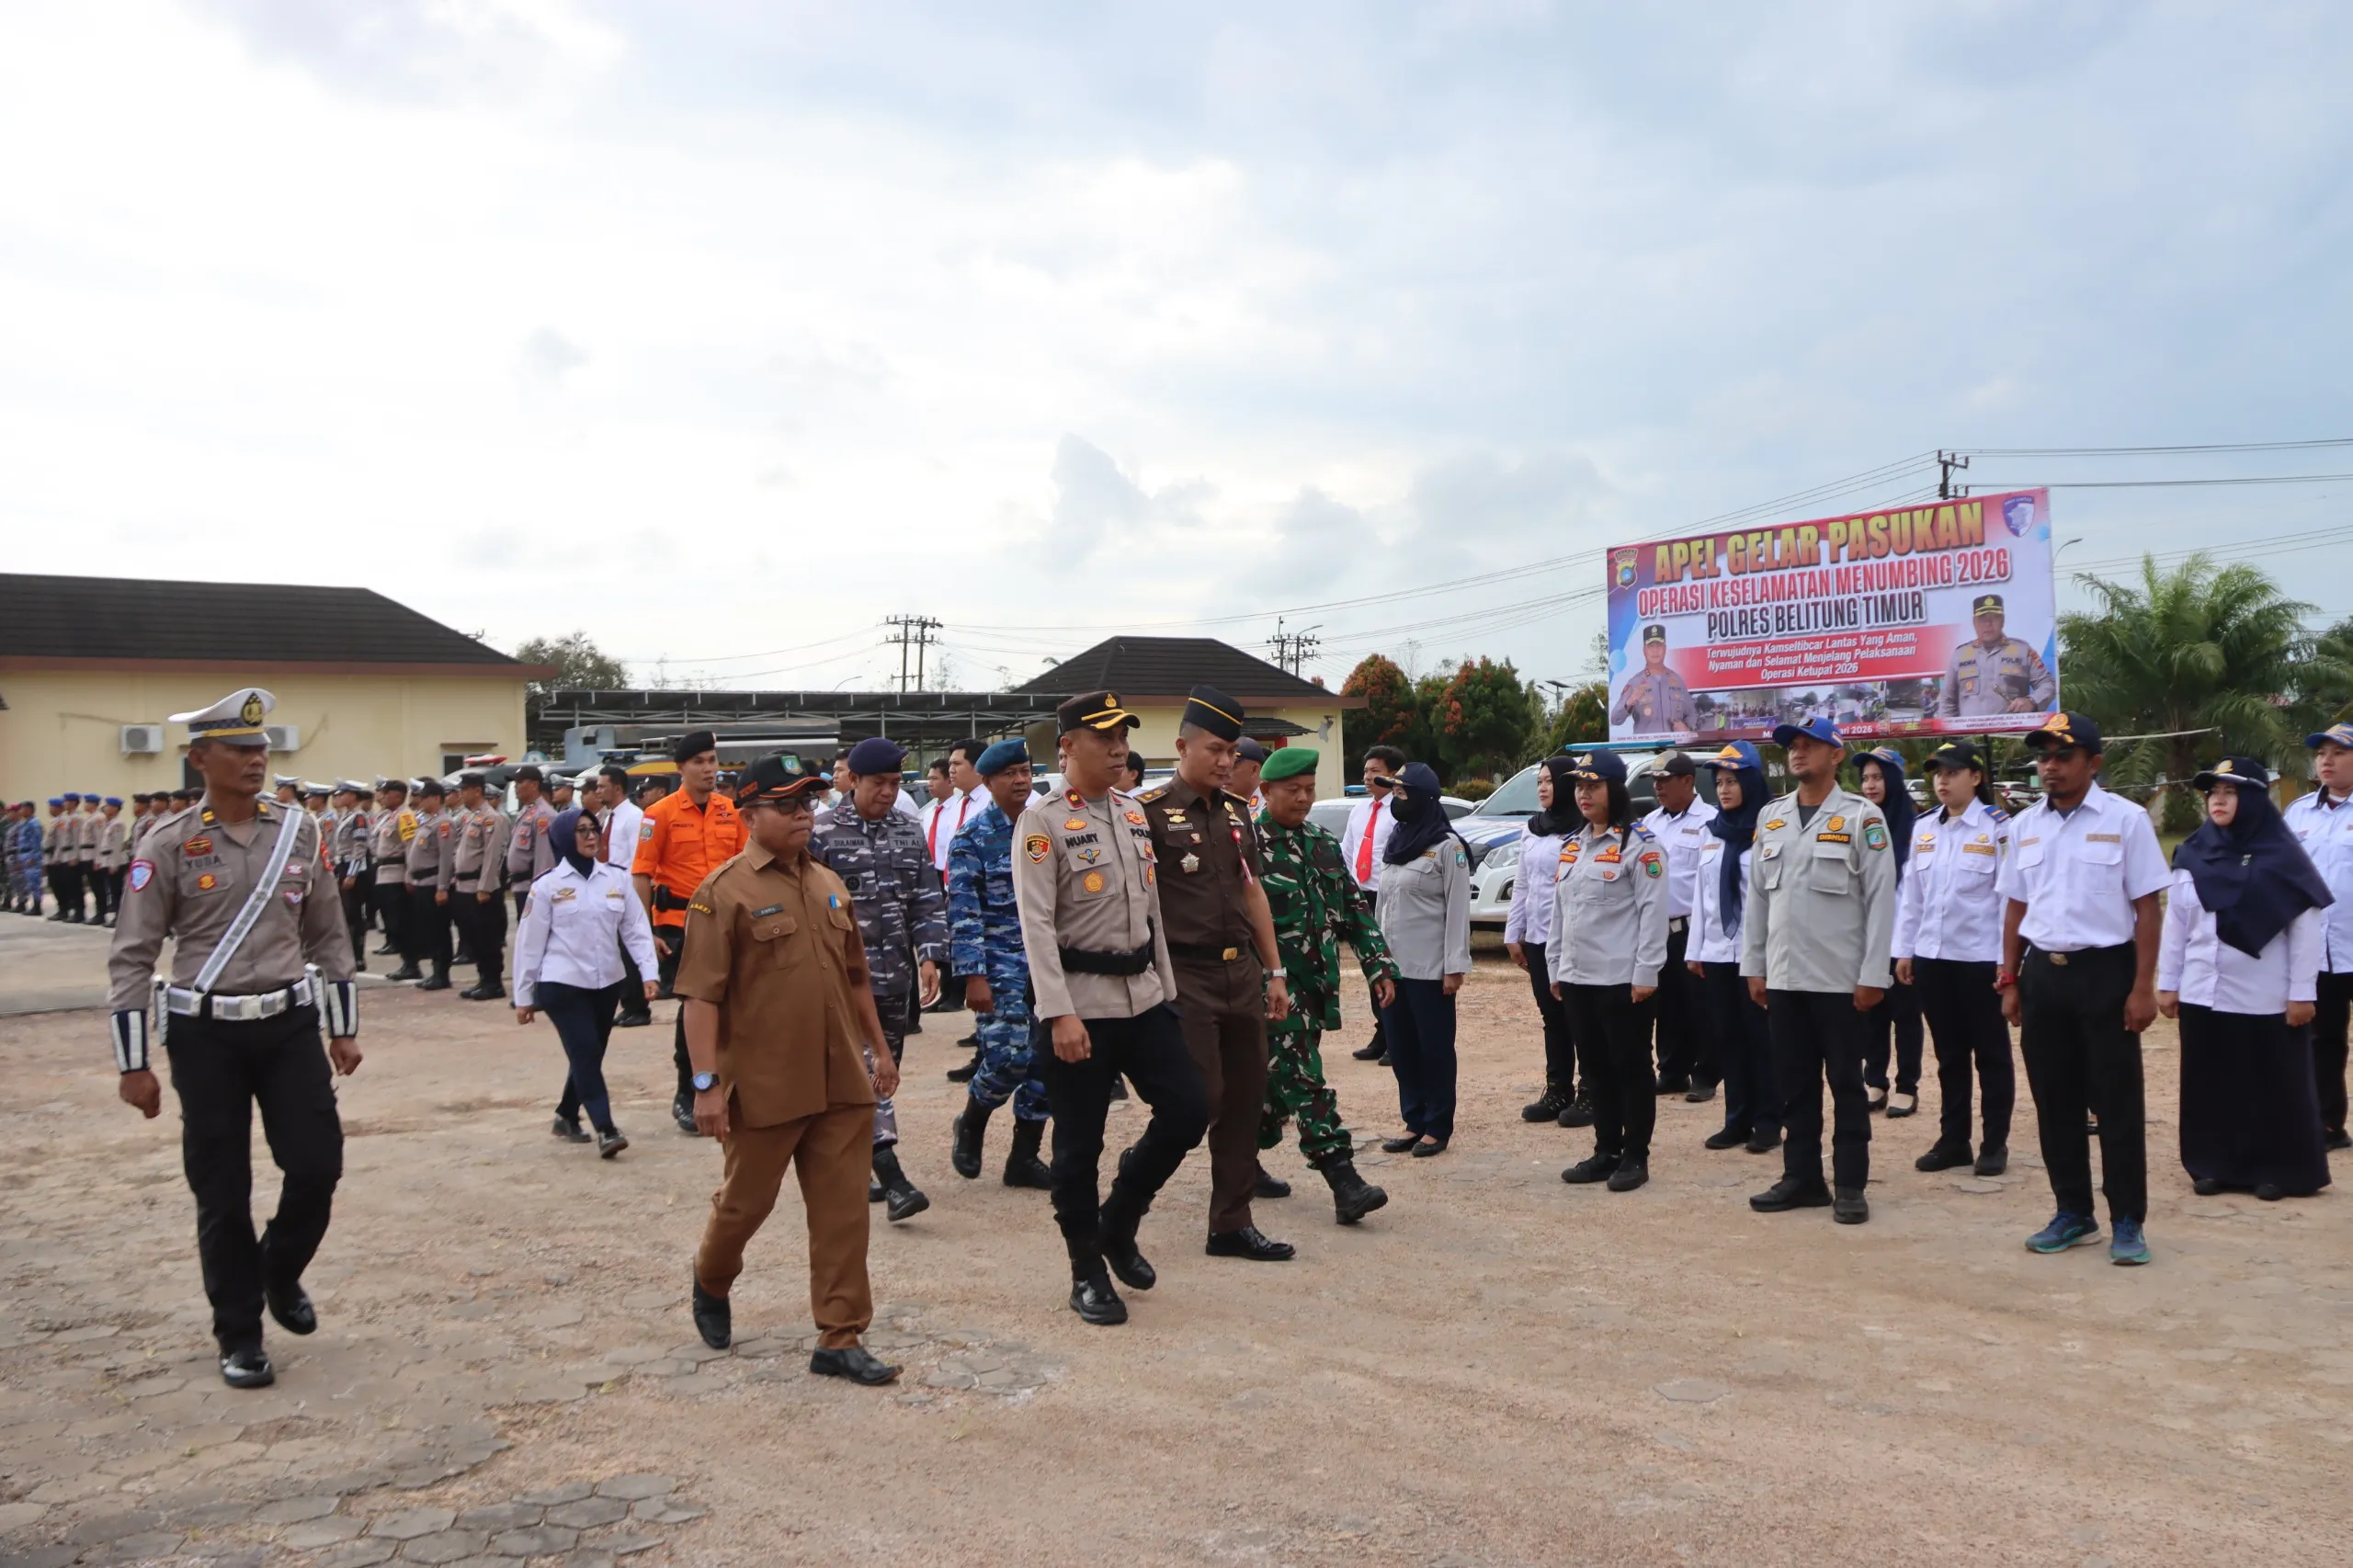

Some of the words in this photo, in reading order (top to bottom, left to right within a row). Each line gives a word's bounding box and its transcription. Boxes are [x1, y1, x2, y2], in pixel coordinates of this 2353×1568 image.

[1654, 538, 1721, 585] APEL
[1727, 525, 1820, 576] GELAR
[1828, 502, 1984, 563] PASUKAN
[1639, 585, 1706, 617] OPERASI
[1710, 569, 1830, 609] KESELAMATAN
[1836, 554, 1952, 597] MENUMBING
[1957, 548, 2009, 583] 2026
[1707, 606, 1770, 640] POLRES
[1776, 597, 1859, 633] BELITUNG
[1862, 591, 1925, 624] TIMUR
[1706, 646, 1762, 660] Terwujudnya
[1764, 641, 1824, 654] Kamseltibcar
[1825, 637, 1858, 649] Lantas
[1860, 634, 1884, 647] Yang
[1886, 631, 1918, 643] Aman,
[1708, 659, 1744, 672] Nyaman
[1746, 657, 1763, 668] dan
[1765, 653, 1802, 666] Selamat
[1804, 650, 1851, 664] Menjelang
[1854, 645, 1915, 659] Pelaksanaan
[1761, 667, 1795, 680] Operasi
[1797, 665, 1833, 678] Ketupat
[1835, 662, 1859, 674] 2026
[1852, 724, 1873, 734] 2026
[1064, 833, 1098, 848] NUARY
[1130, 827, 1152, 838] POL
[1818, 834, 1849, 842] DISHUB
